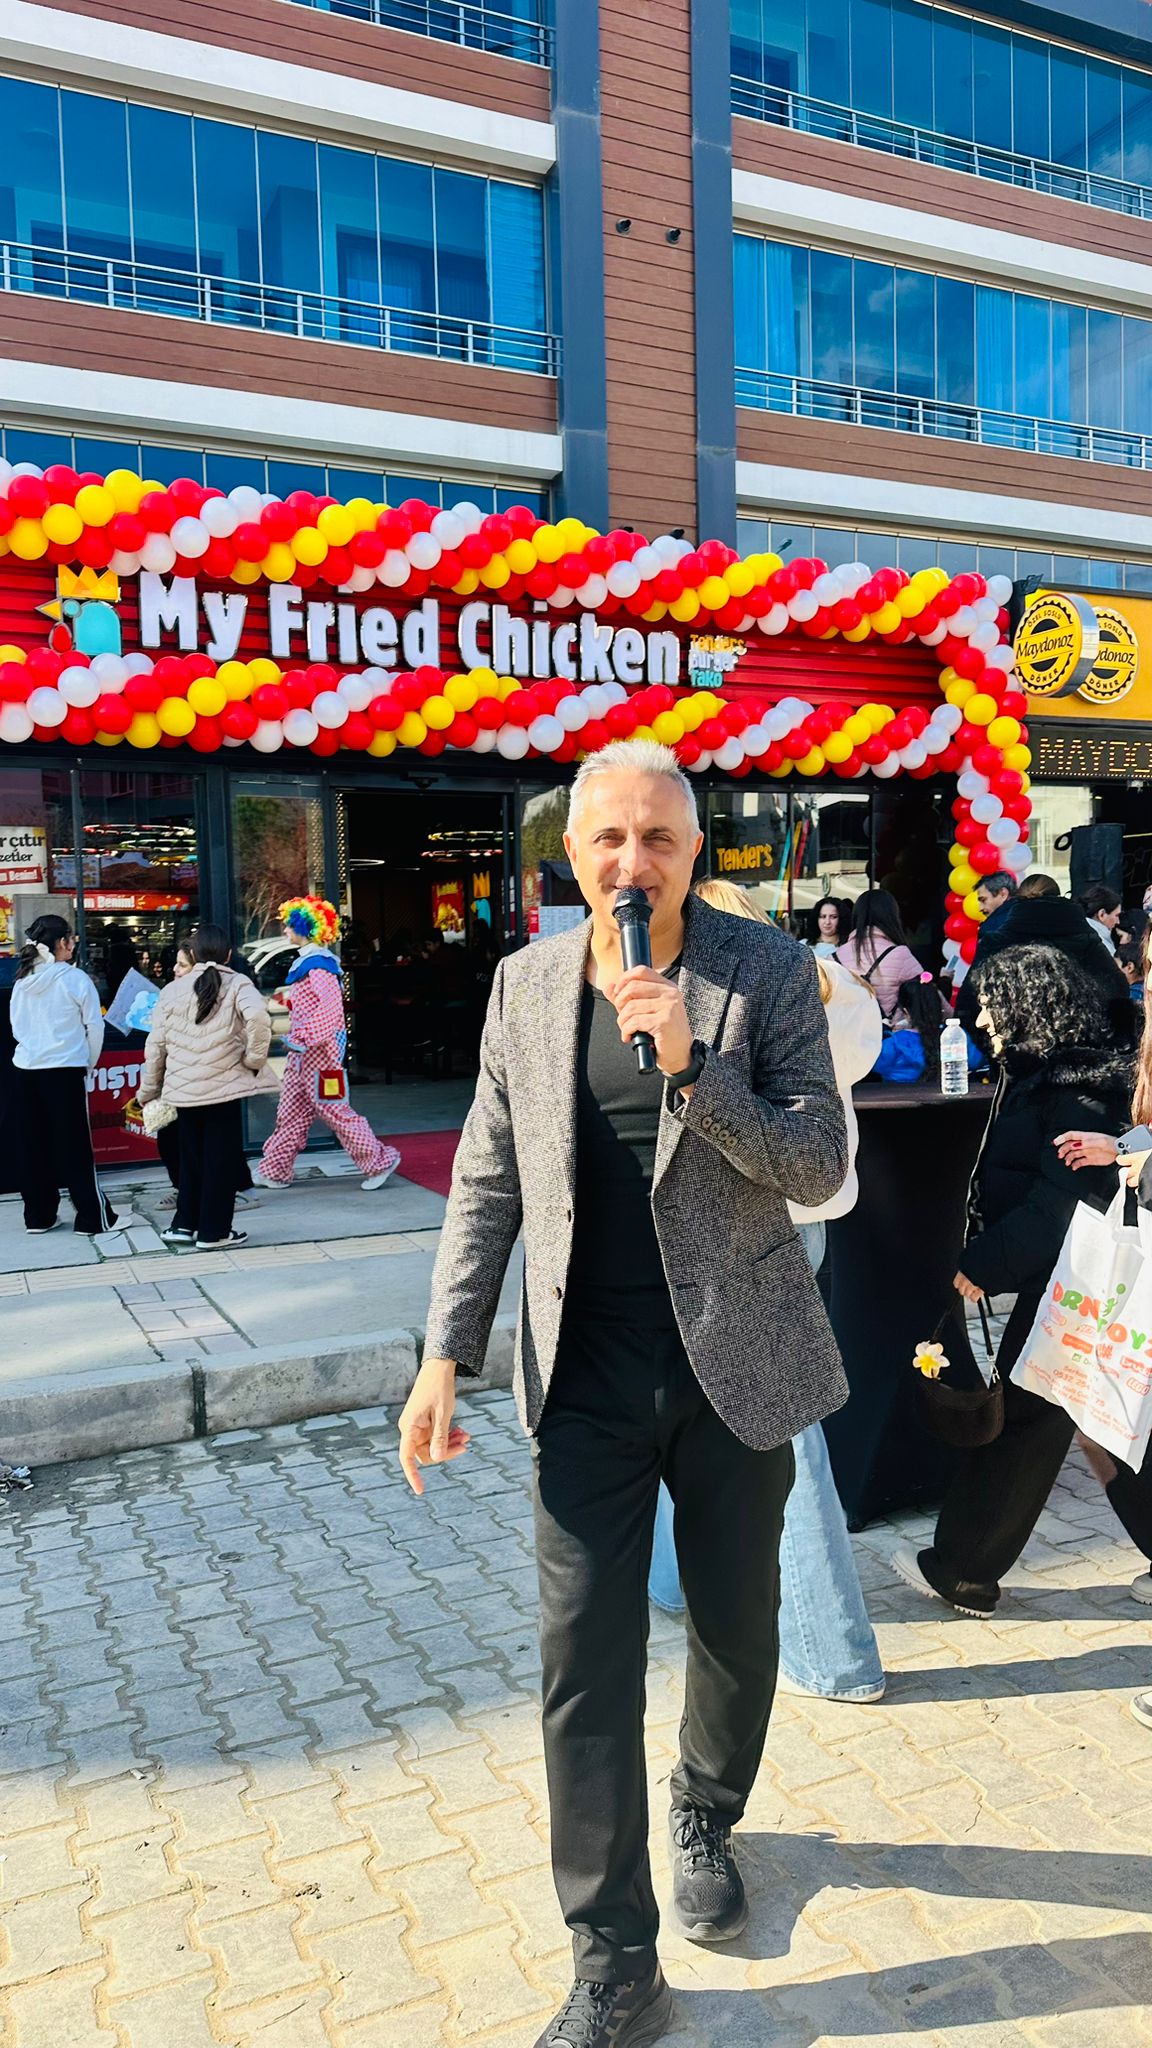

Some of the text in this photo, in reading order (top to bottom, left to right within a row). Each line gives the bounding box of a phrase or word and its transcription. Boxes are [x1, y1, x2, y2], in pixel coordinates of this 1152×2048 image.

[138, 571, 680, 685] My Fried Chicken
[1028, 609, 1062, 628] ÖZEL SOSLU
[1103, 622, 1123, 637] SOSLU
[689, 634, 746, 653] Tenders
[1015, 634, 1074, 660] Maydonoz
[691, 669, 724, 688] Tako
[1029, 668, 1059, 683] DÖNER
[1089, 678, 1119, 690] DÖNER
[716, 843, 773, 872] Tenders
[1127, 1377, 1149, 1396] LEGO
